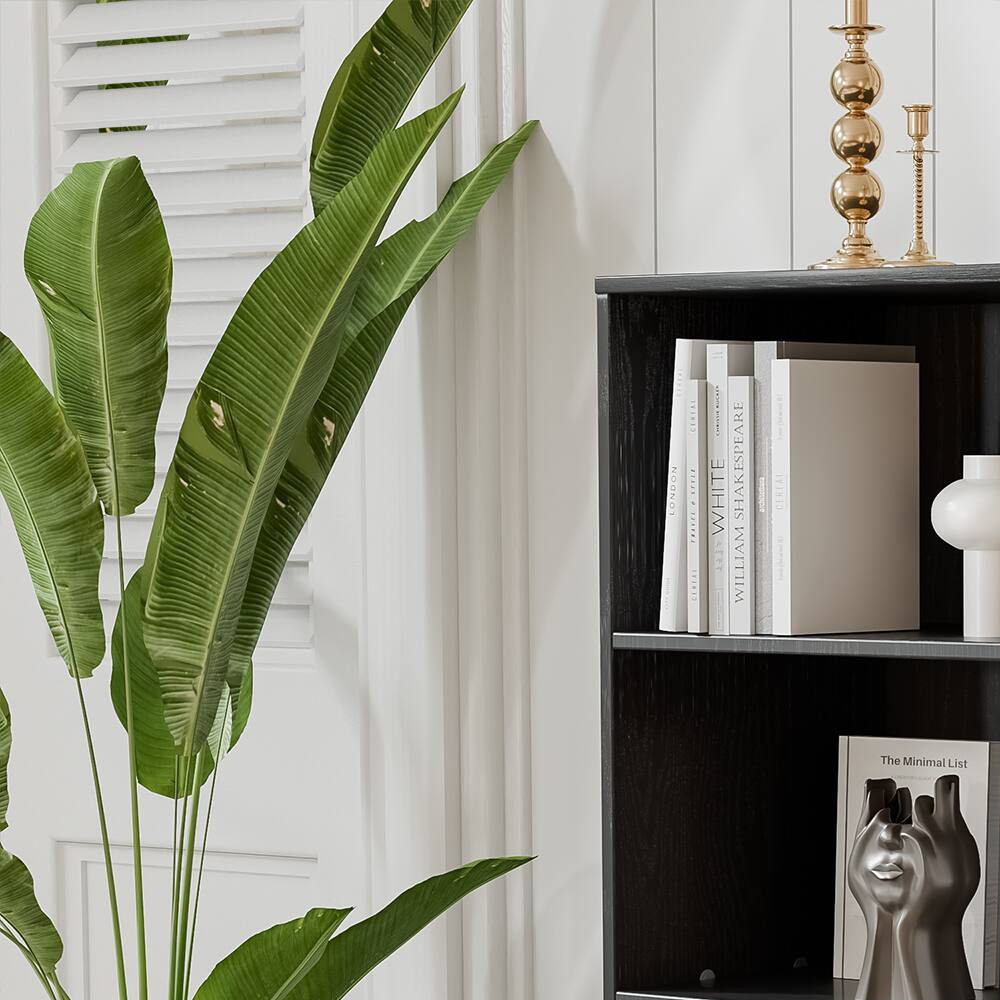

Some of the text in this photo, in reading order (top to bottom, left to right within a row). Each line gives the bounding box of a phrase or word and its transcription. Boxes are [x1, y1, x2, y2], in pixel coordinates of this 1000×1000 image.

[668, 465, 678, 517] LONDON
[711, 458, 726, 536] WHITE
[733, 401, 745, 604] WILLIAM SHAKESPEARE
[880, 755, 968, 769] The Minimal List
